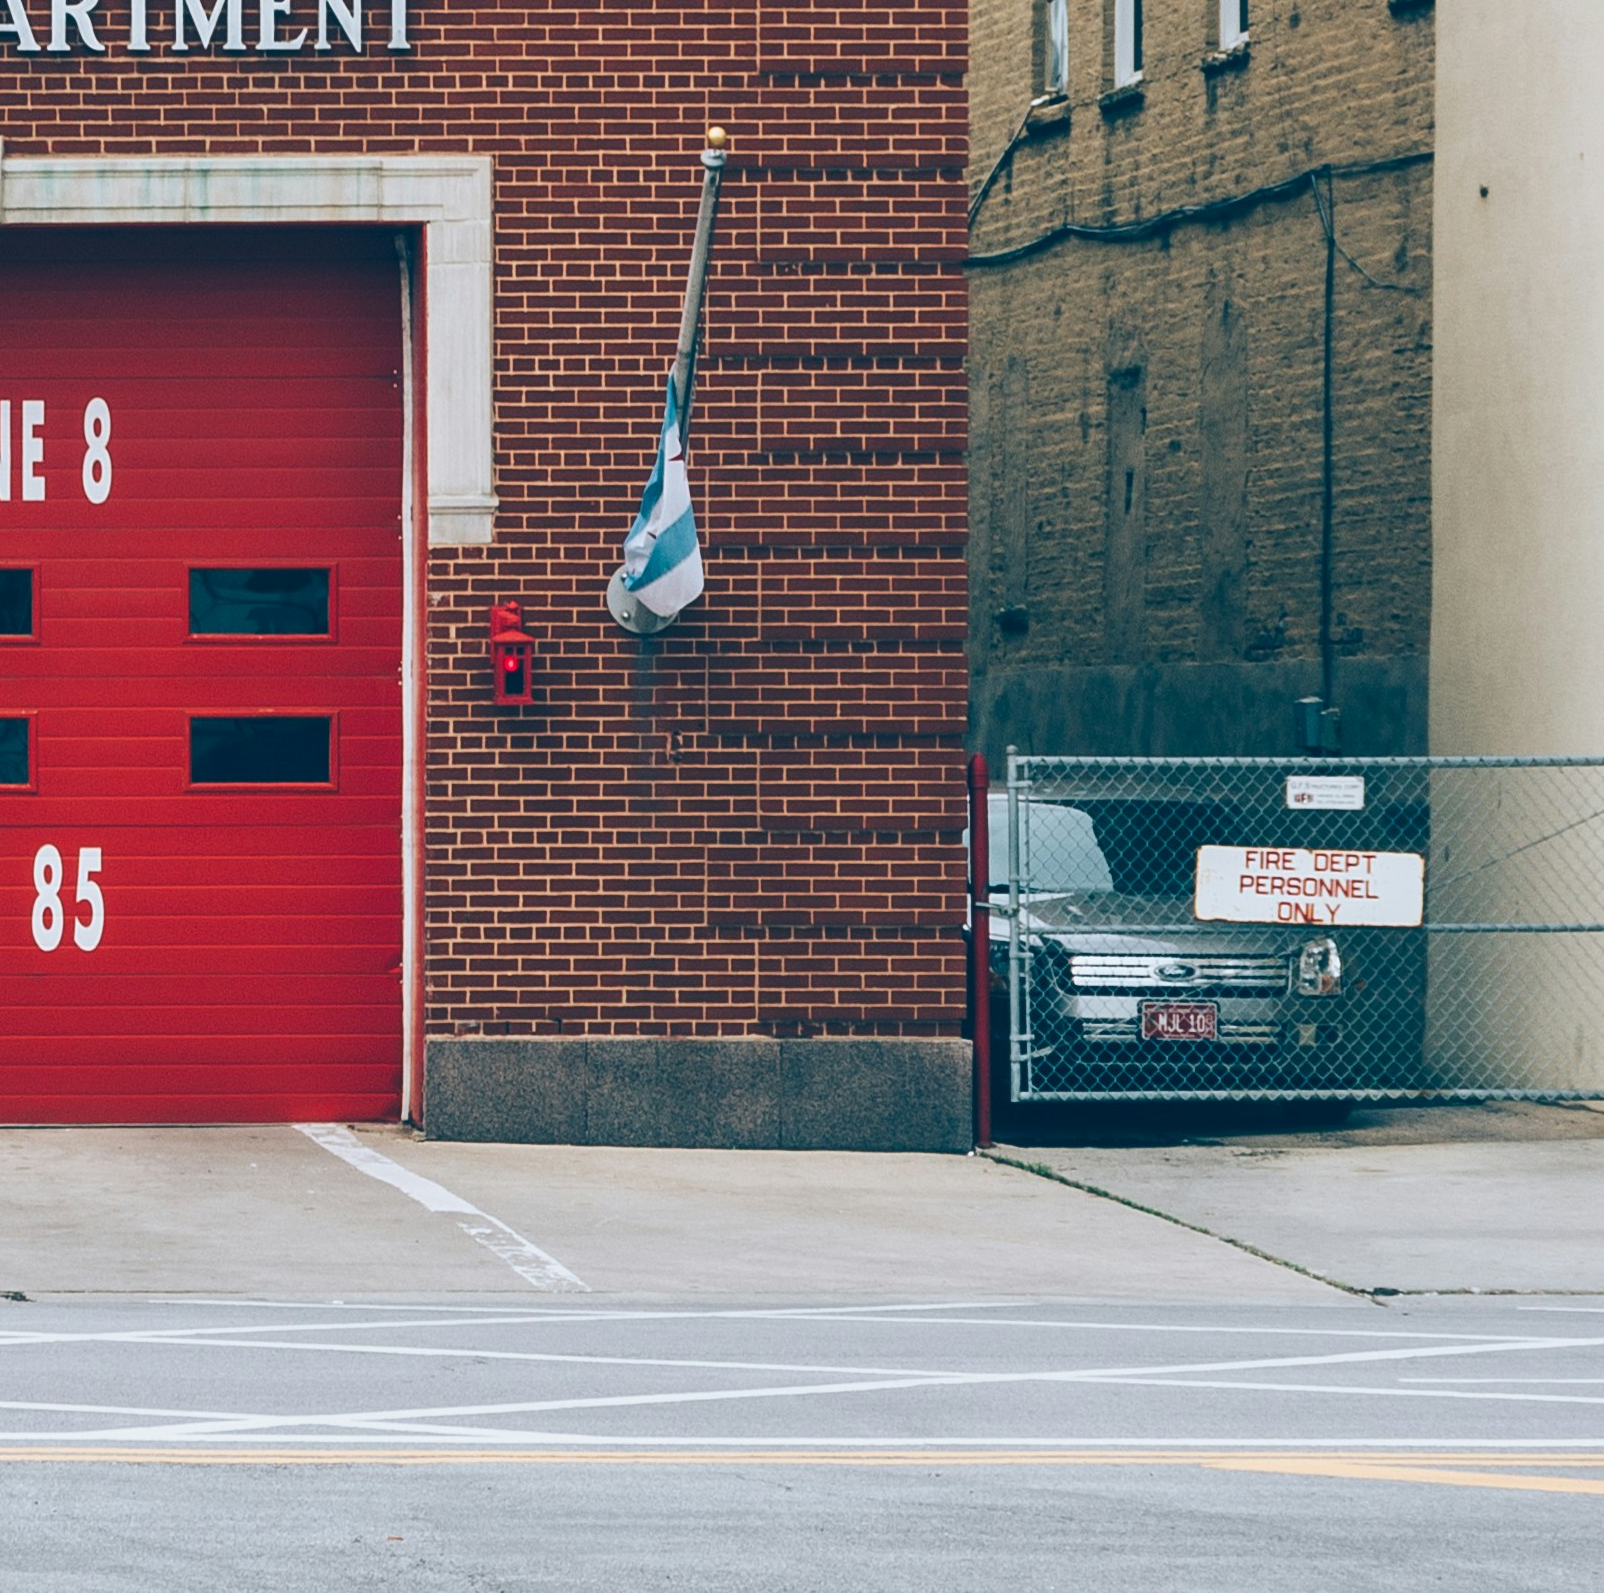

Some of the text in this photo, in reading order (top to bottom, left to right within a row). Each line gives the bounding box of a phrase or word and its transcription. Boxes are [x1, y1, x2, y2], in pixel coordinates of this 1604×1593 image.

[82, 397, 113, 505] 8
[1245, 850, 1377, 875] FIRE DEPT
[31, 844, 105, 952] 85
[1239, 874, 1380, 899] PERSONNEL
[1277, 901, 1342, 923] ONLY
